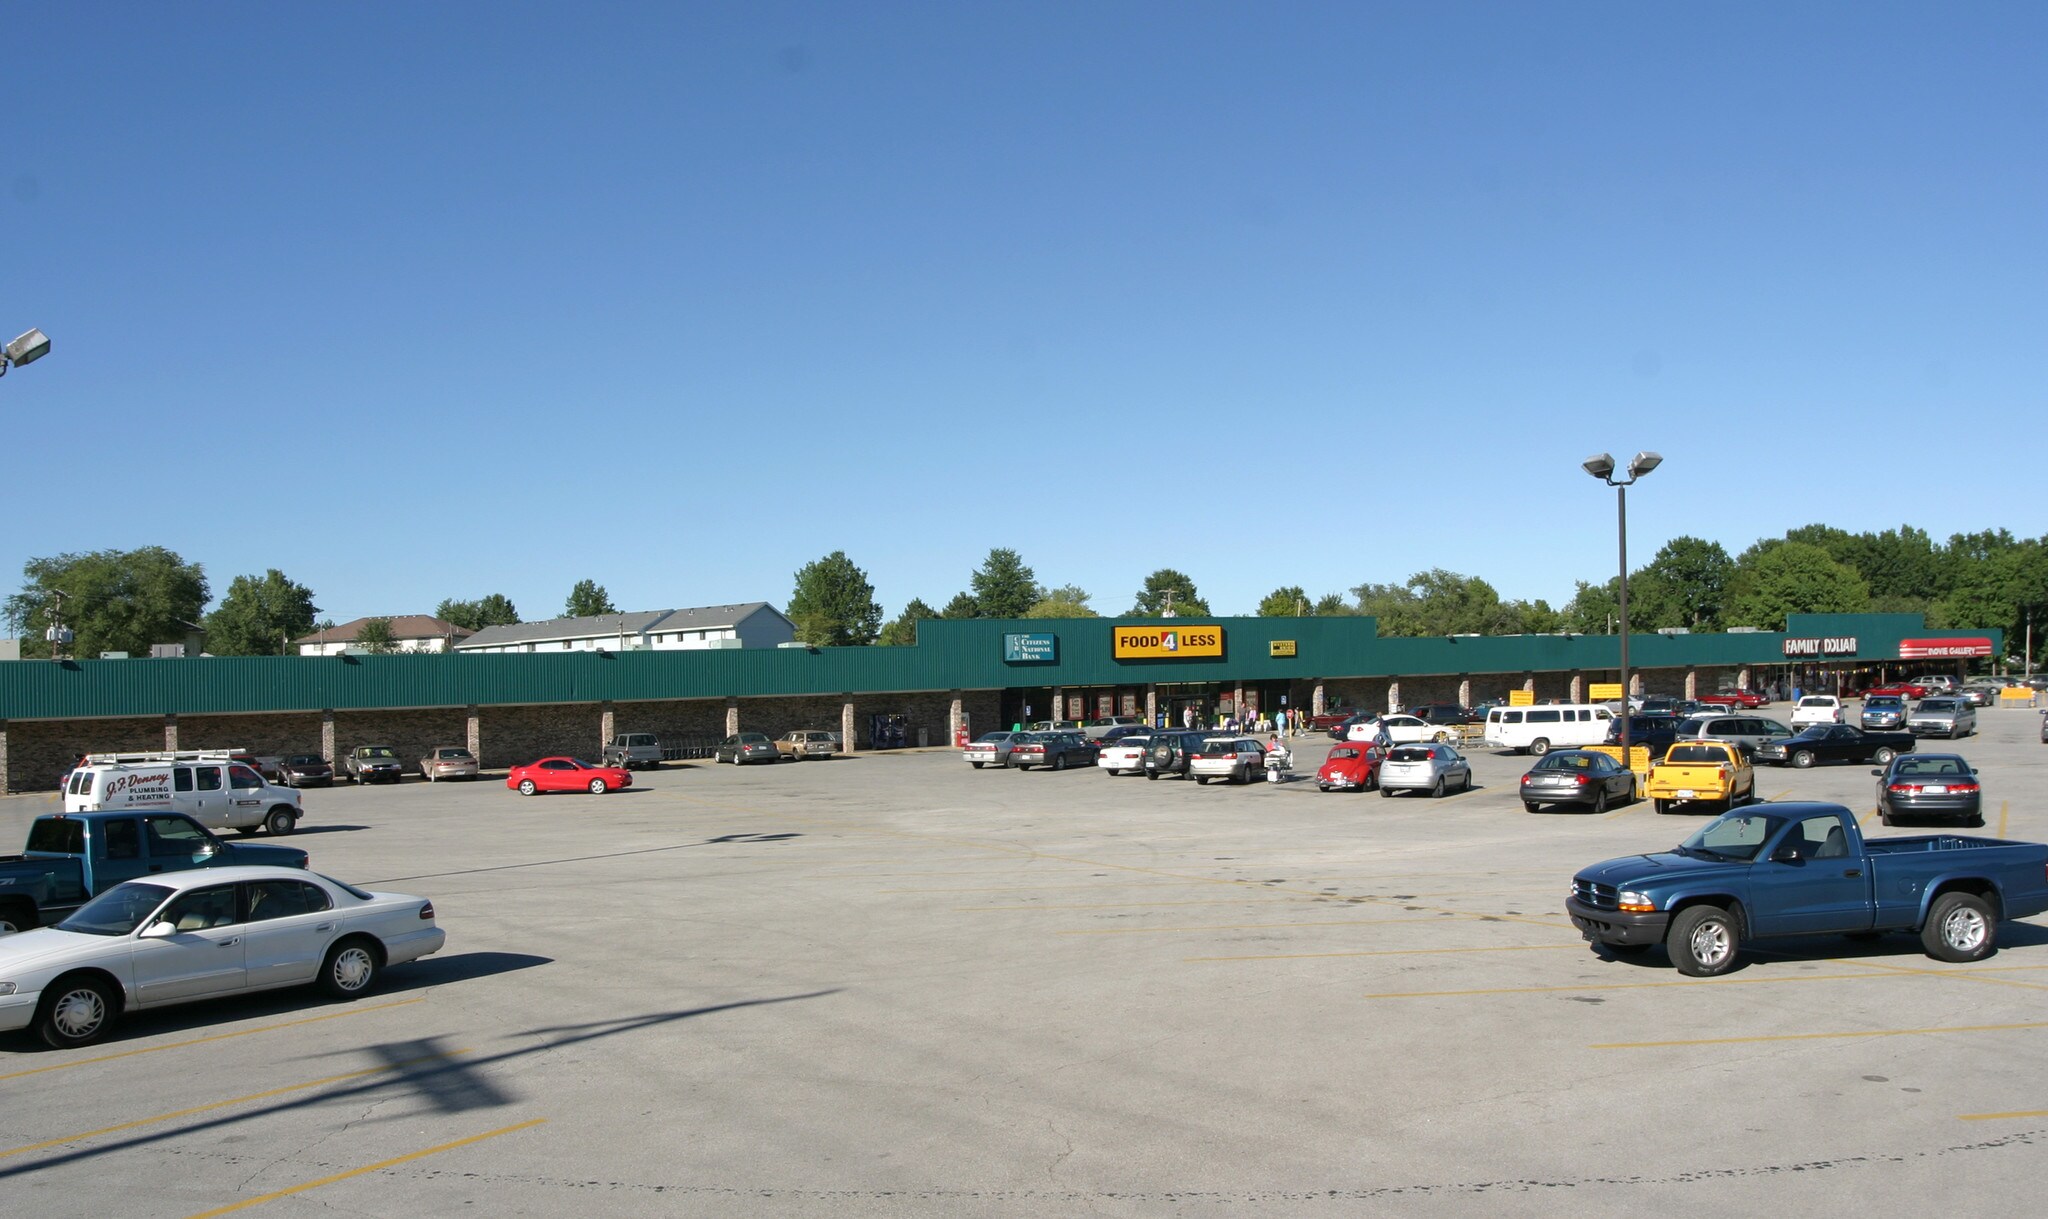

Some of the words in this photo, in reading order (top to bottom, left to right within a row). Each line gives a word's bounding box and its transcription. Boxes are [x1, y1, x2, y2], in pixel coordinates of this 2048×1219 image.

[1121, 636, 1159, 648] FOOD
[1163, 634, 1175, 649] 4
[1182, 635, 1215, 646] LESS
[1785, 639, 1820, 653] FAMILY
[1824, 638, 1856, 653] DOLLAR
[1928, 647, 1948, 655] MOVIE
[1949, 647, 1975, 655] GALLERY
[128, 774, 170, 787] Denney
